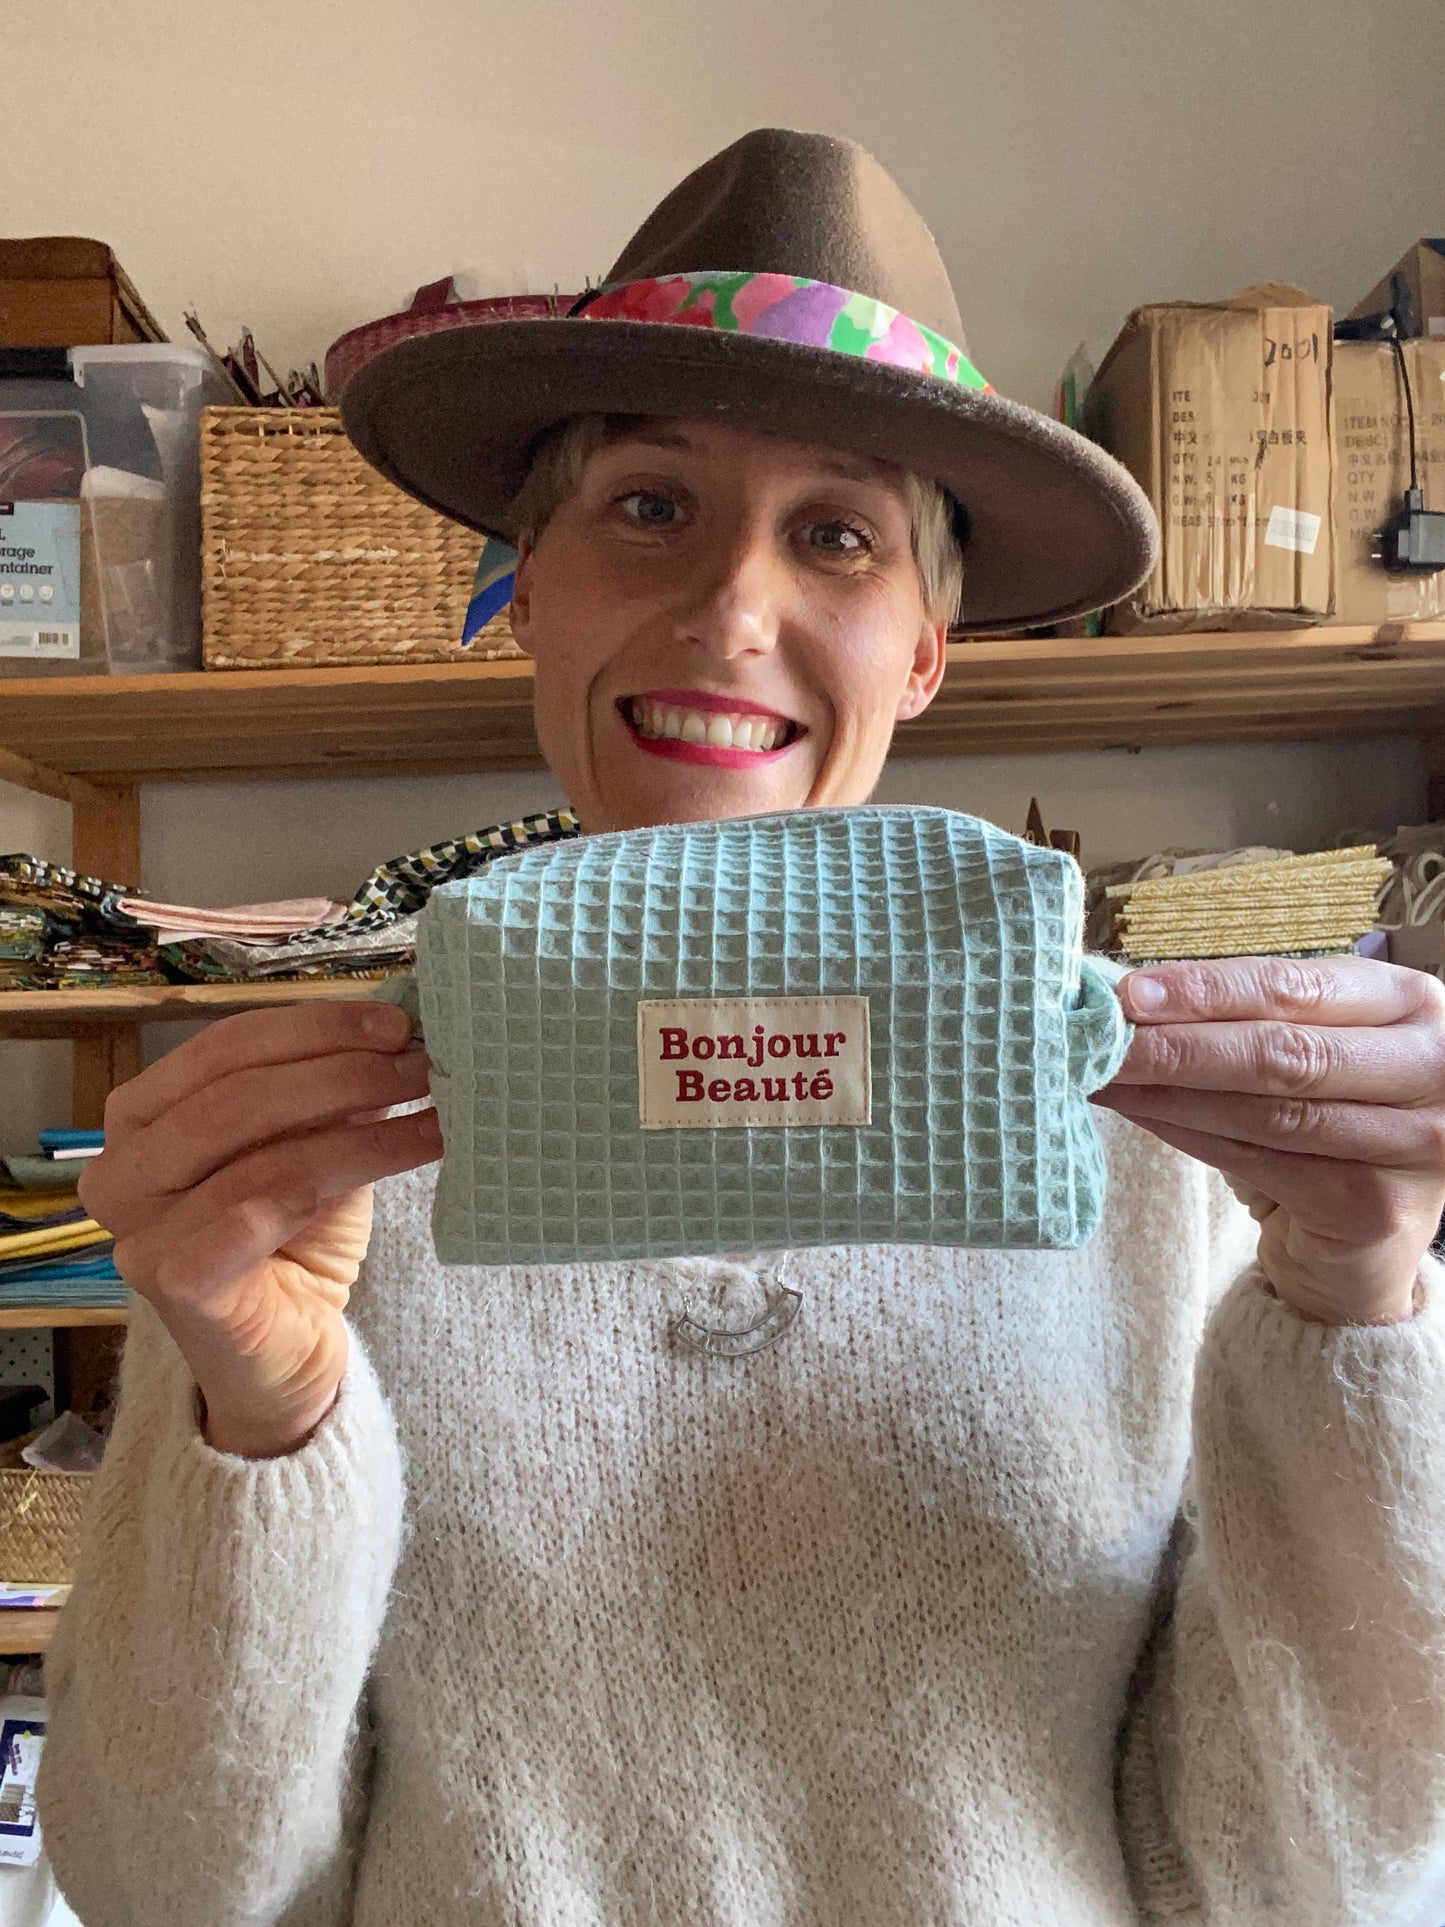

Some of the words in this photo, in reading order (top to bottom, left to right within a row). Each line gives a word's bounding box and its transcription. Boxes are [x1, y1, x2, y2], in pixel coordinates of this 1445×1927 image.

[0, 546, 36, 561] rage
[659, 1025, 847, 1068] Bonjour
[675, 1068, 835, 1103] Beauté
